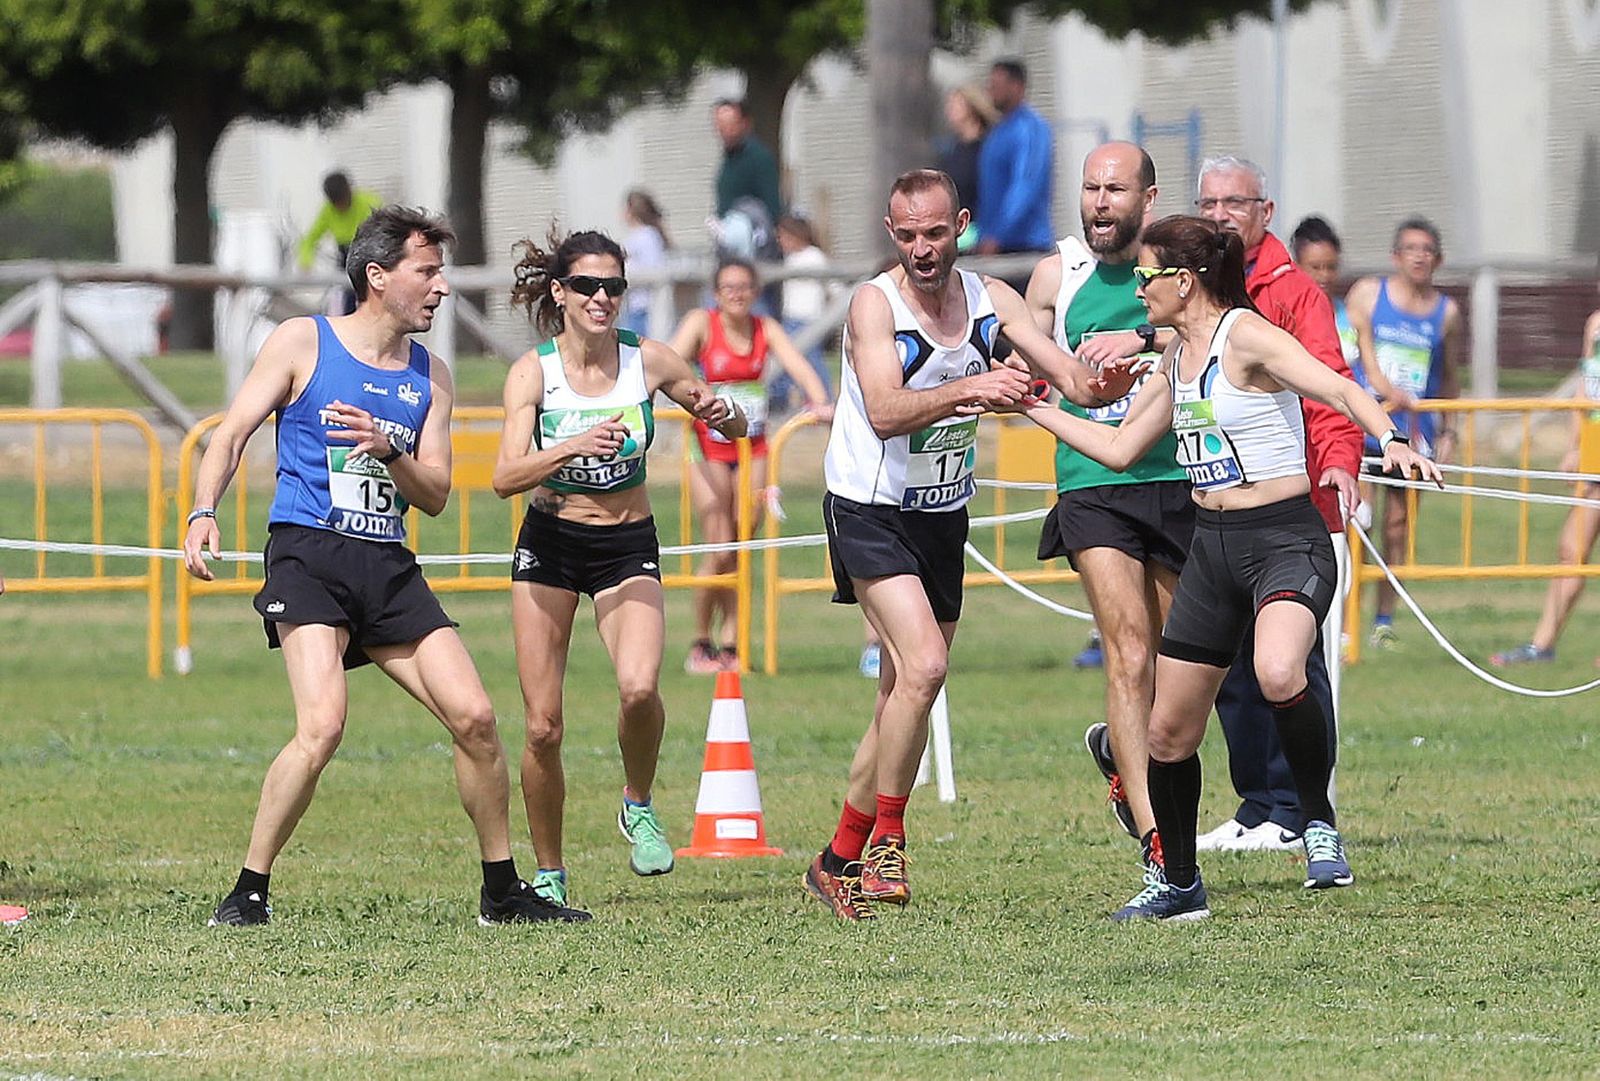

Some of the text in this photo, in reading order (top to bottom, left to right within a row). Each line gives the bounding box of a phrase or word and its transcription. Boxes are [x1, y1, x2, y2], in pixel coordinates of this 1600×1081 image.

[1179, 431, 1201, 463] 17
[936, 450, 966, 483] 17
[360, 480, 394, 513] 15
